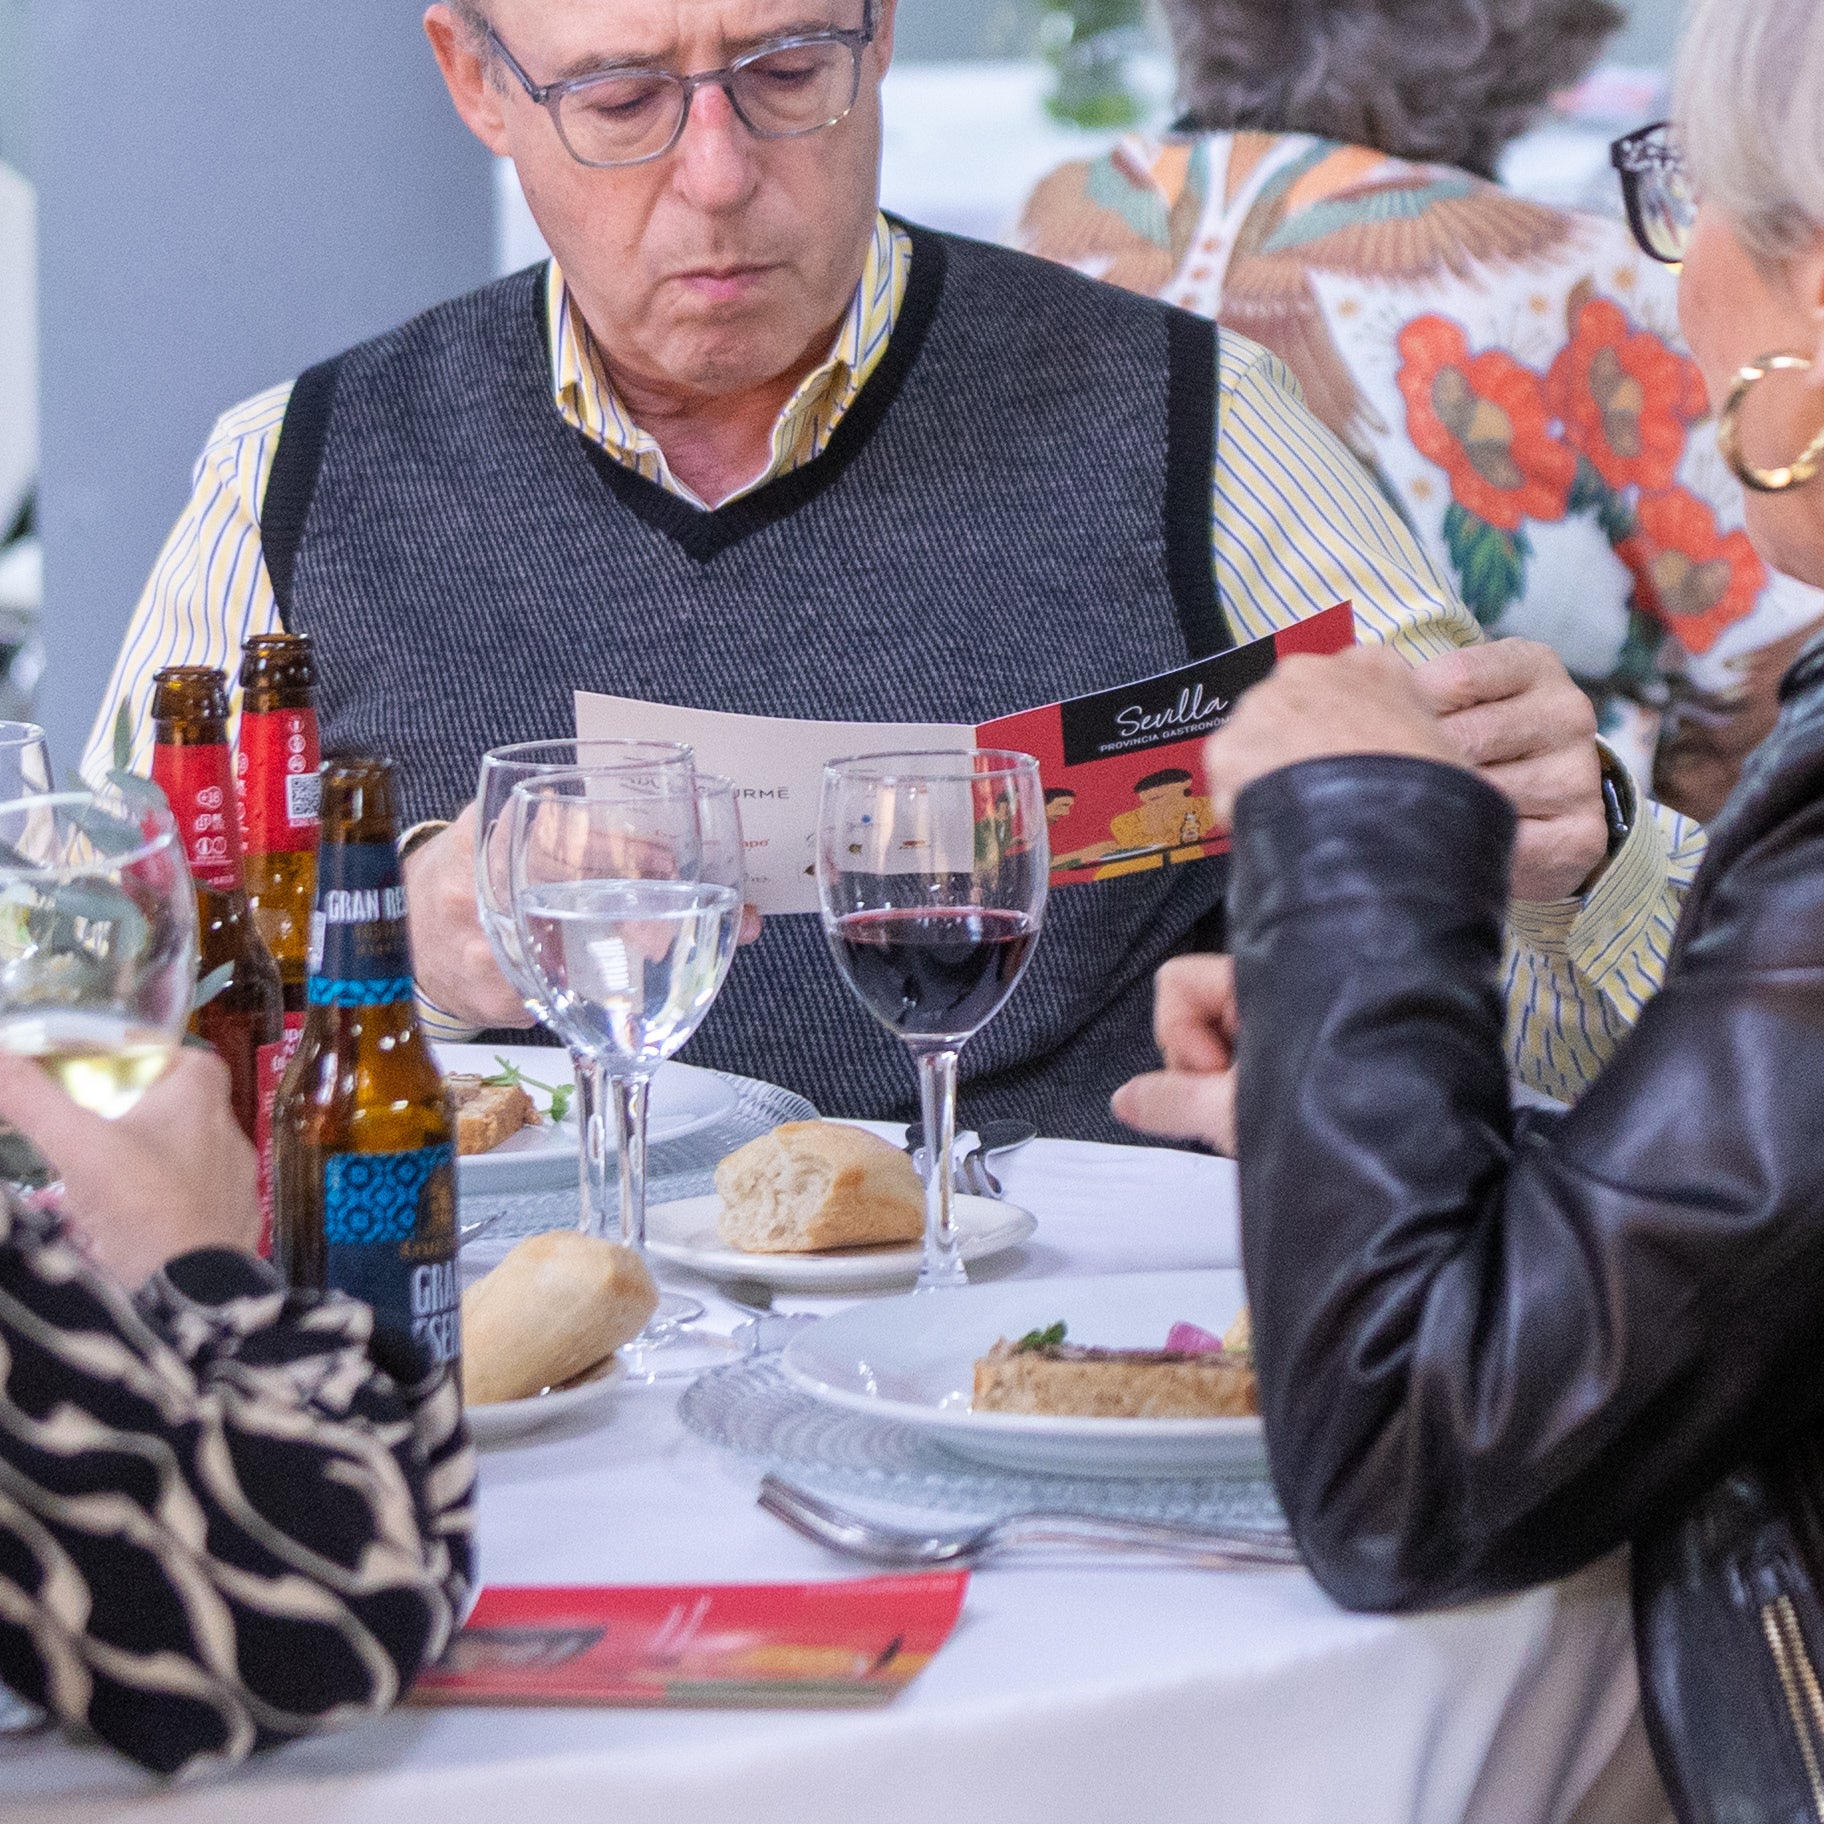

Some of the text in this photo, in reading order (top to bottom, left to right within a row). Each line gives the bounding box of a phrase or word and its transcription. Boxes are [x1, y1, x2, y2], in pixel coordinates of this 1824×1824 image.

[1116, 683, 1229, 737] Sevilla
[1099, 716, 1231, 752] PROVINCIA GASTRONÓM
[326, 886, 408, 923] GRAN RE
[411, 1262, 460, 1318] GRA
